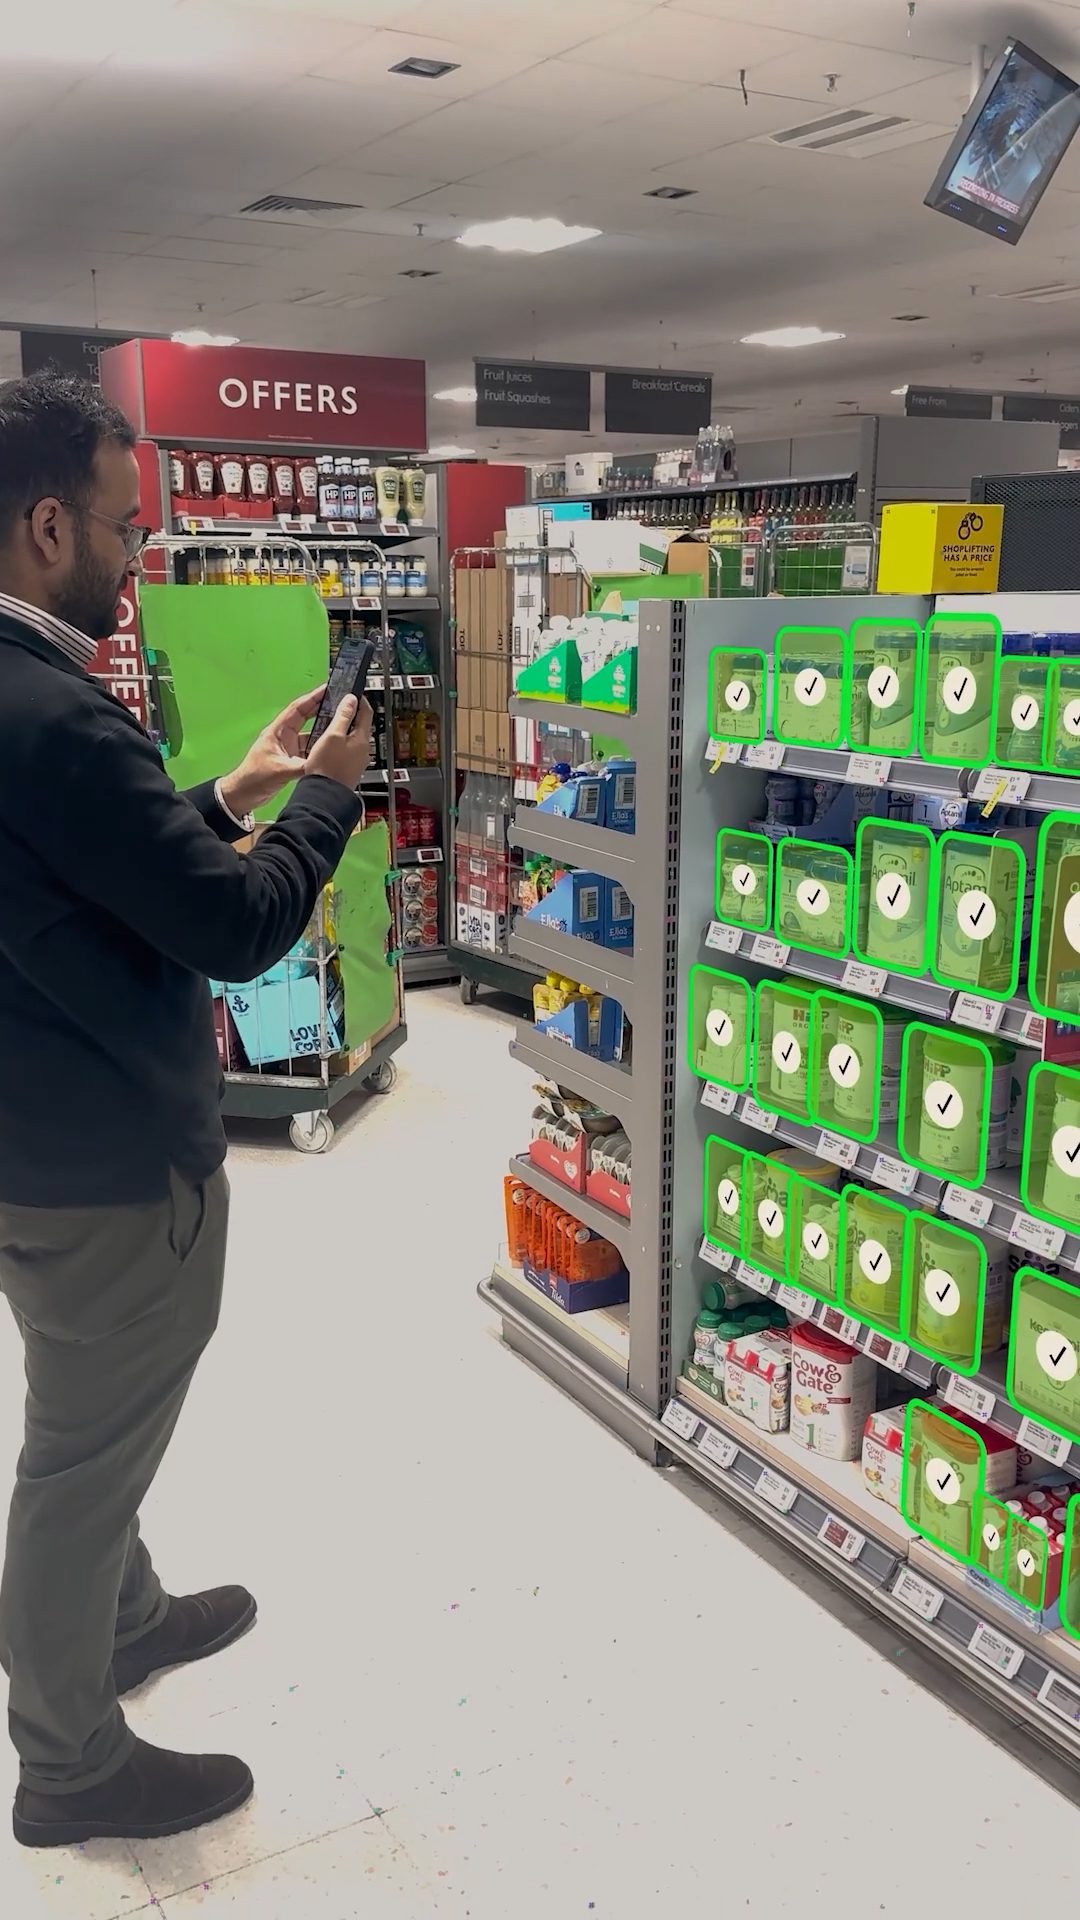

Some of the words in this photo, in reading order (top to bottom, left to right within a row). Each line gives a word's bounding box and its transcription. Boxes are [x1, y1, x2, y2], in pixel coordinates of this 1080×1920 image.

[483, 368, 505, 381] Fruit
[505, 370, 533, 384] Juices
[632, 378, 673, 392] Breakfast
[674, 381, 706, 393] Cereals
[218, 377, 359, 416] OFFERS
[484, 389, 505, 401] Fruit
[507, 391, 551, 405] Squashes
[911, 395, 928, 405] Free
[928, 396, 947, 407] From
[326, 490, 339, 500] HP
[344, 491, 357, 500] HP
[363, 491, 375, 501] HP
[942, 545, 995, 553] SHOPLIFTING
[943, 554, 960, 562] HAS
[970, 554, 993, 562] PRICE
[796, 1370, 834, 1395] Gate
[806, 1424, 816, 1449] 1
